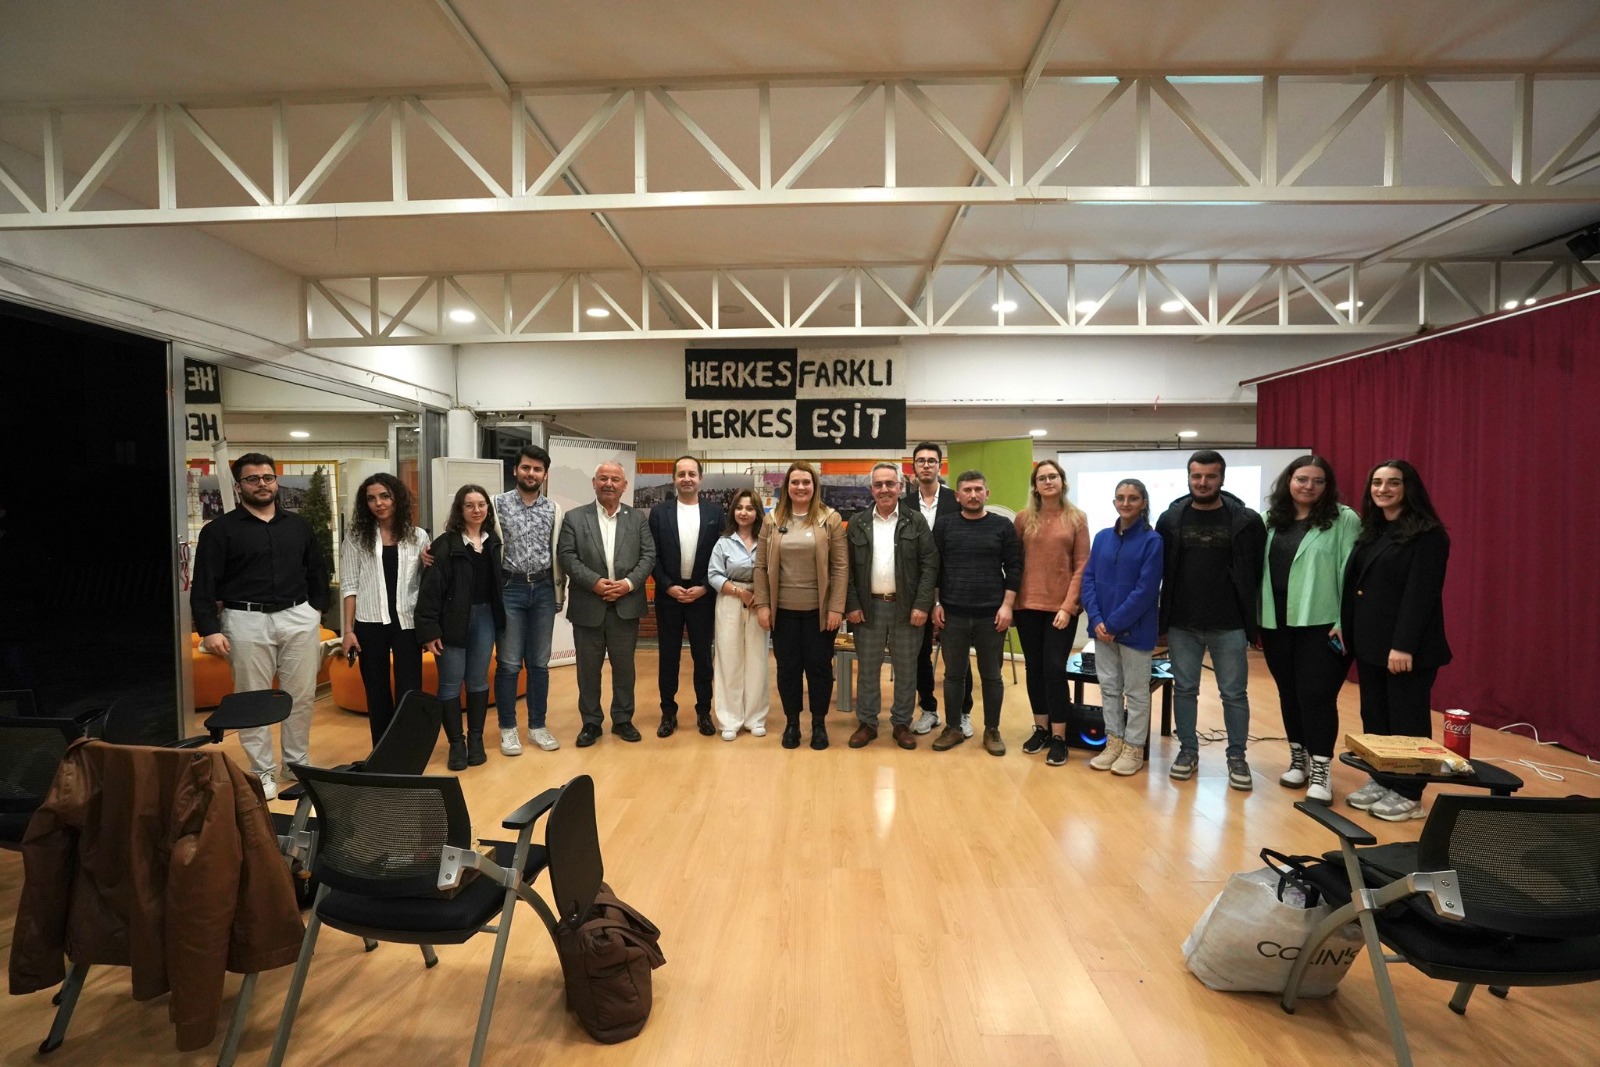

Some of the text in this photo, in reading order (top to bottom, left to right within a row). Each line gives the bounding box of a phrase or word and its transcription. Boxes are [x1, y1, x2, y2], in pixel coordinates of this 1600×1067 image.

[690, 359, 893, 388] HERKES FARKLI
[691, 408, 793, 439] HERKES
[1256, 941, 1360, 966] COIN'S
